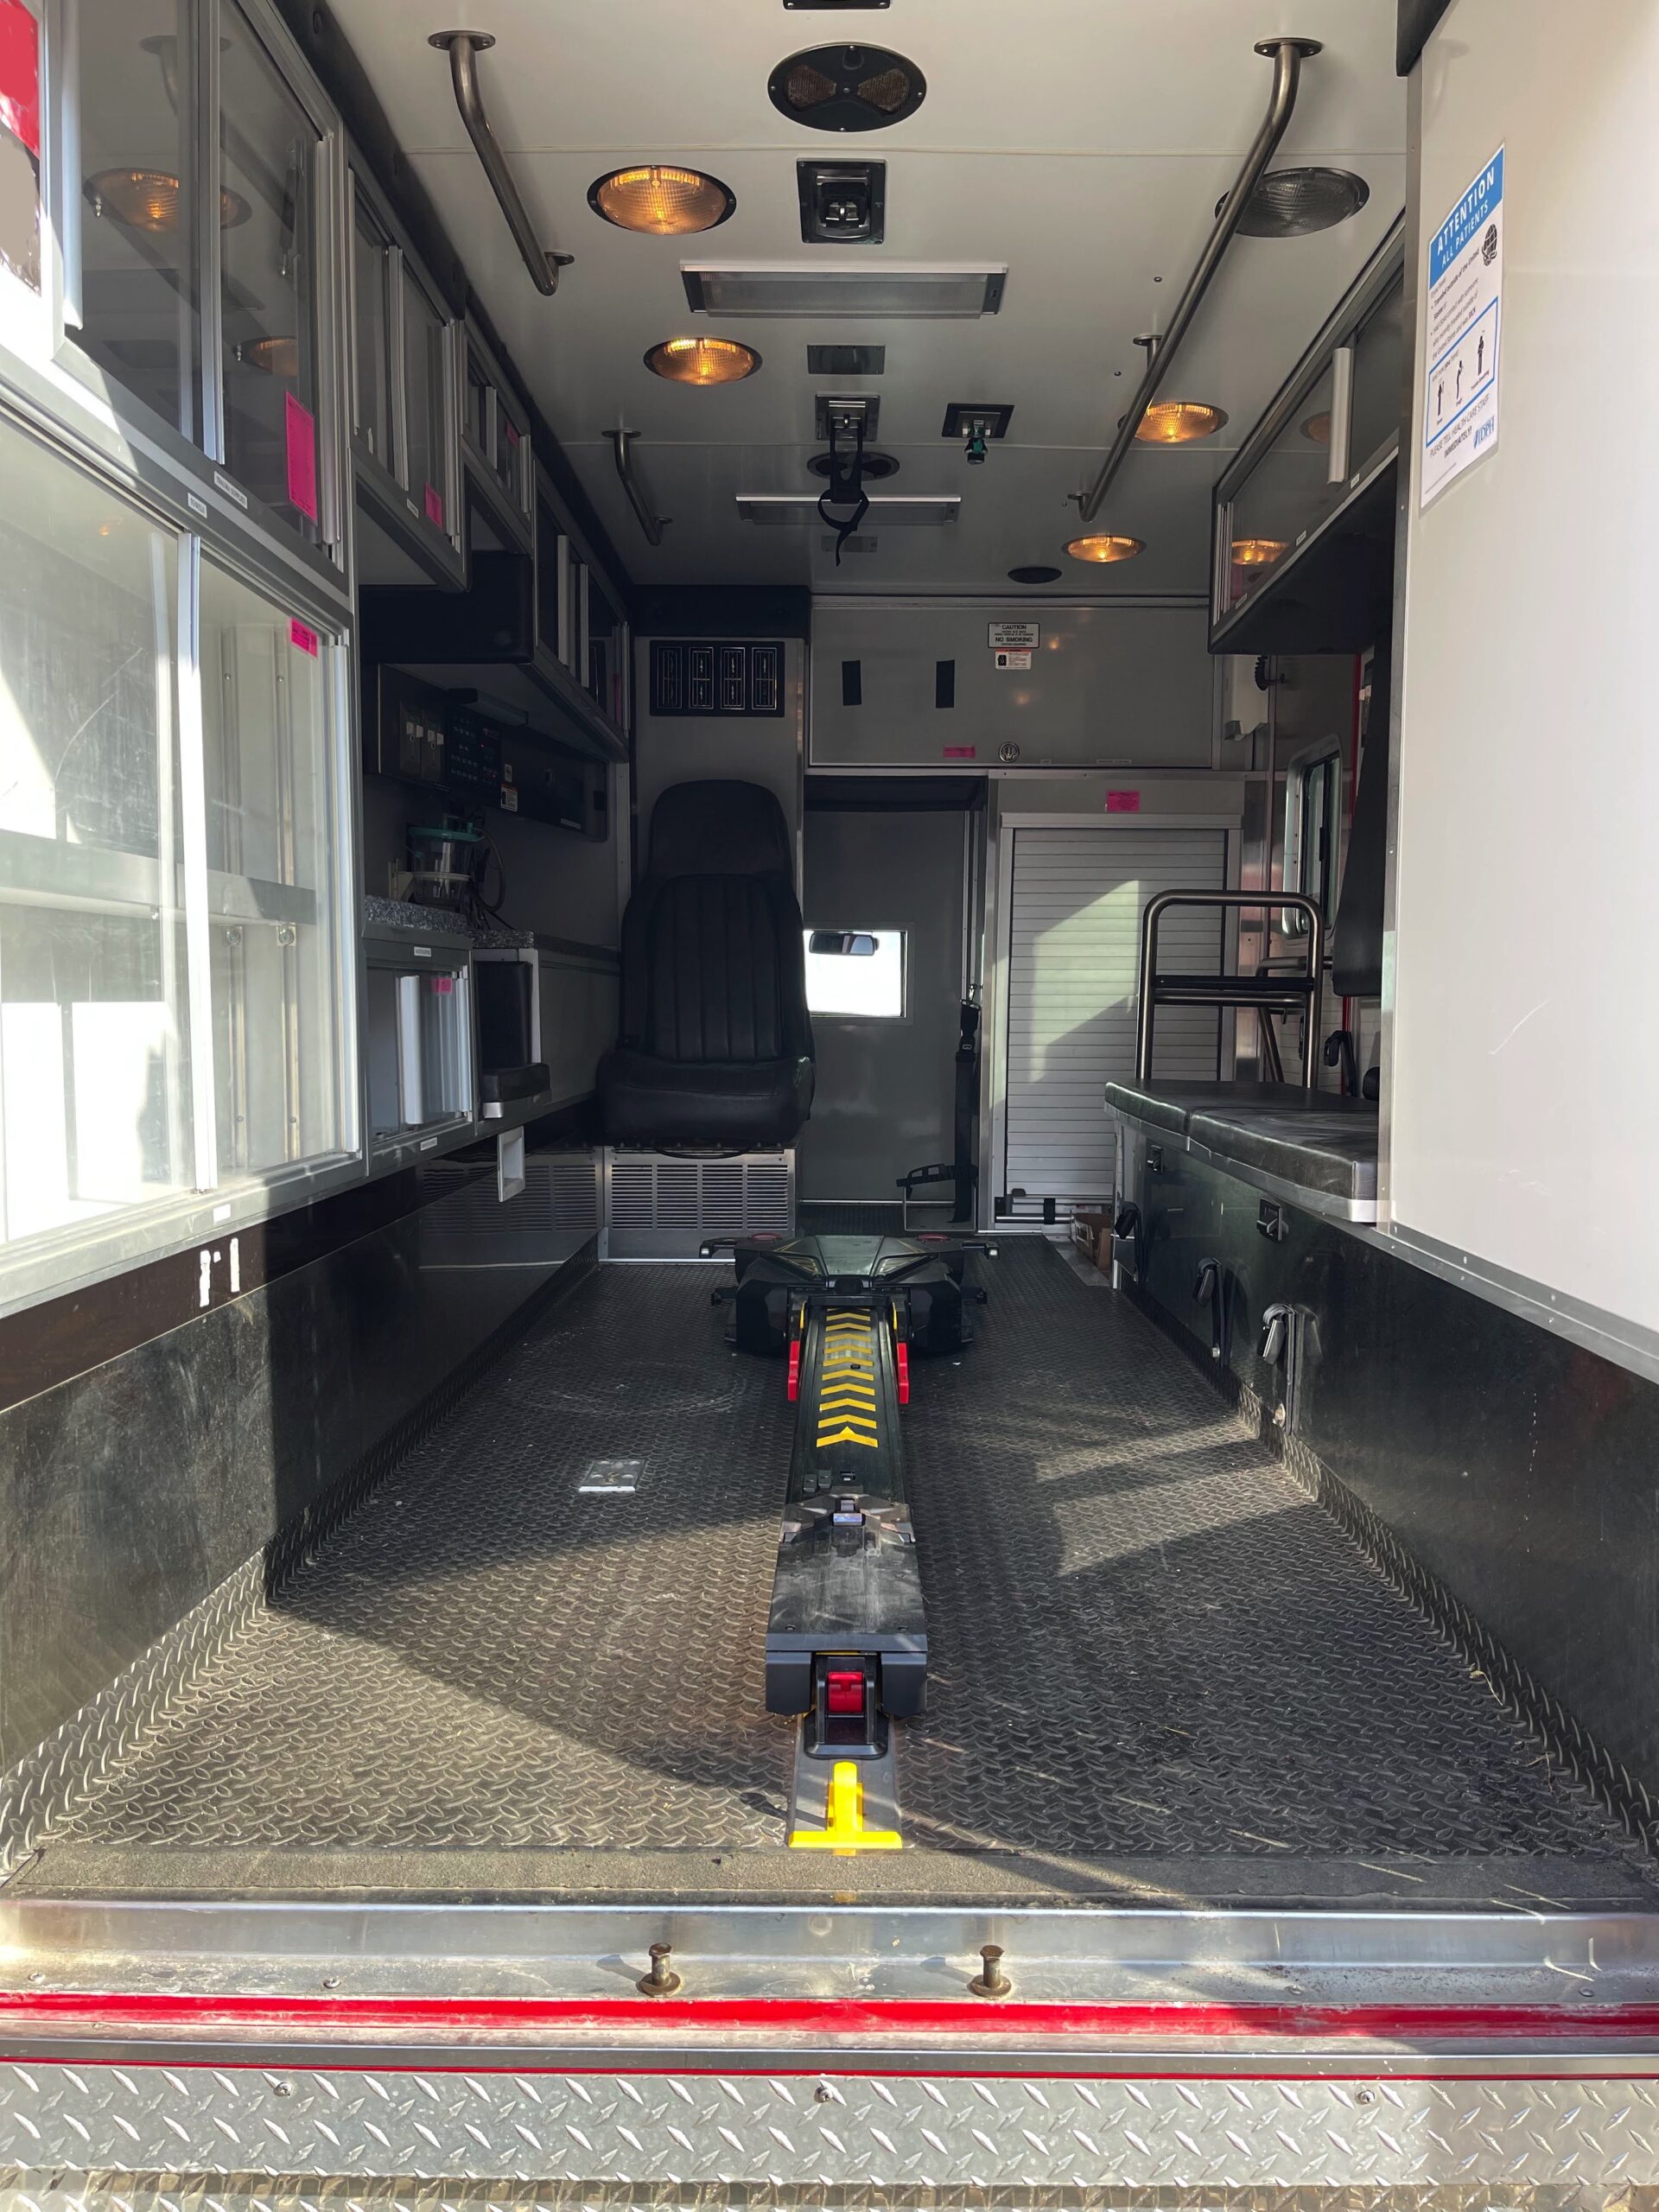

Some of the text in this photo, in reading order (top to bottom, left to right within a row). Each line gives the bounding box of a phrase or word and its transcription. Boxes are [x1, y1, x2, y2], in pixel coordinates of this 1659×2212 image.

[1438, 167, 1494, 257] ATTENTION
[1442, 200, 1488, 268] ALL PATIENTS
[1430, 440, 1443, 458] PLEASE
[1452, 416, 1466, 437] HEALTH
[1467, 405, 1478, 422] CARE
